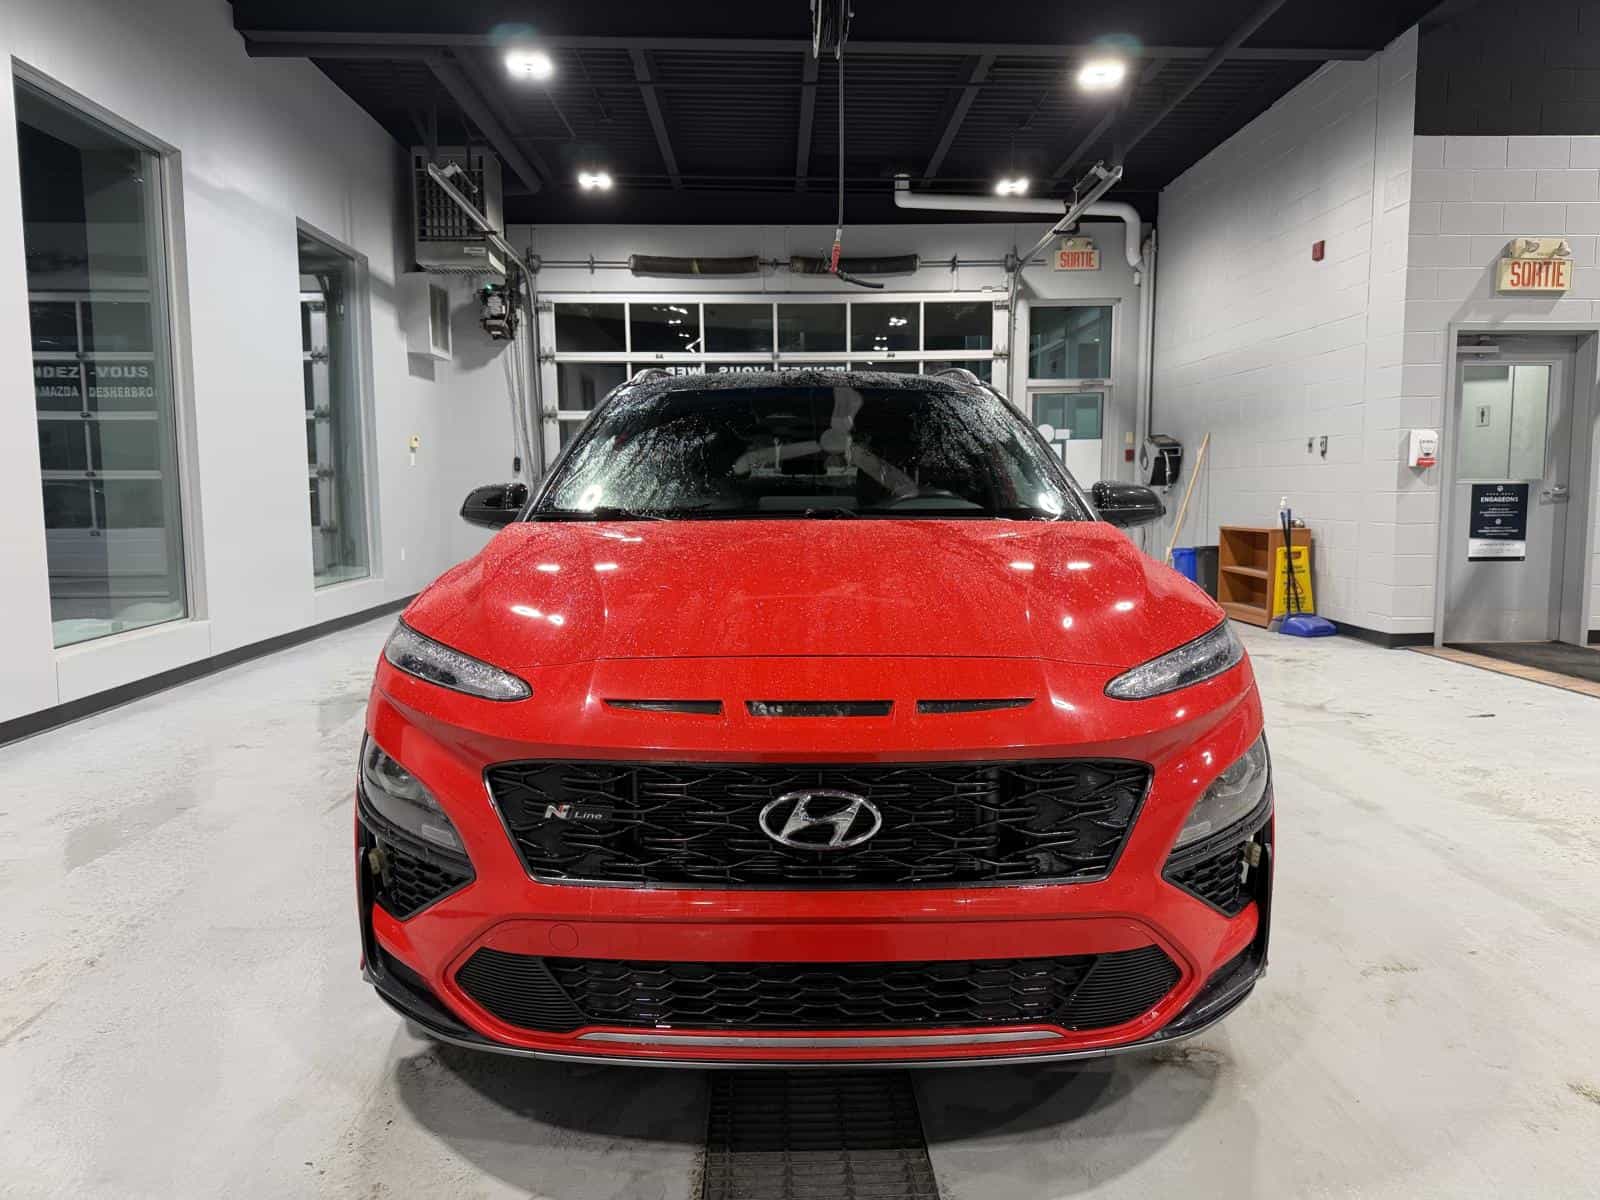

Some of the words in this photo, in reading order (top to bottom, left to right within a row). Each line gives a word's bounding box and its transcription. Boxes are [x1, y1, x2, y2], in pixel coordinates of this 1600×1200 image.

[1060, 251, 1095, 268] SORTIE
[1510, 261, 1566, 288] SORTIE
[575, 811, 602, 819] Line
